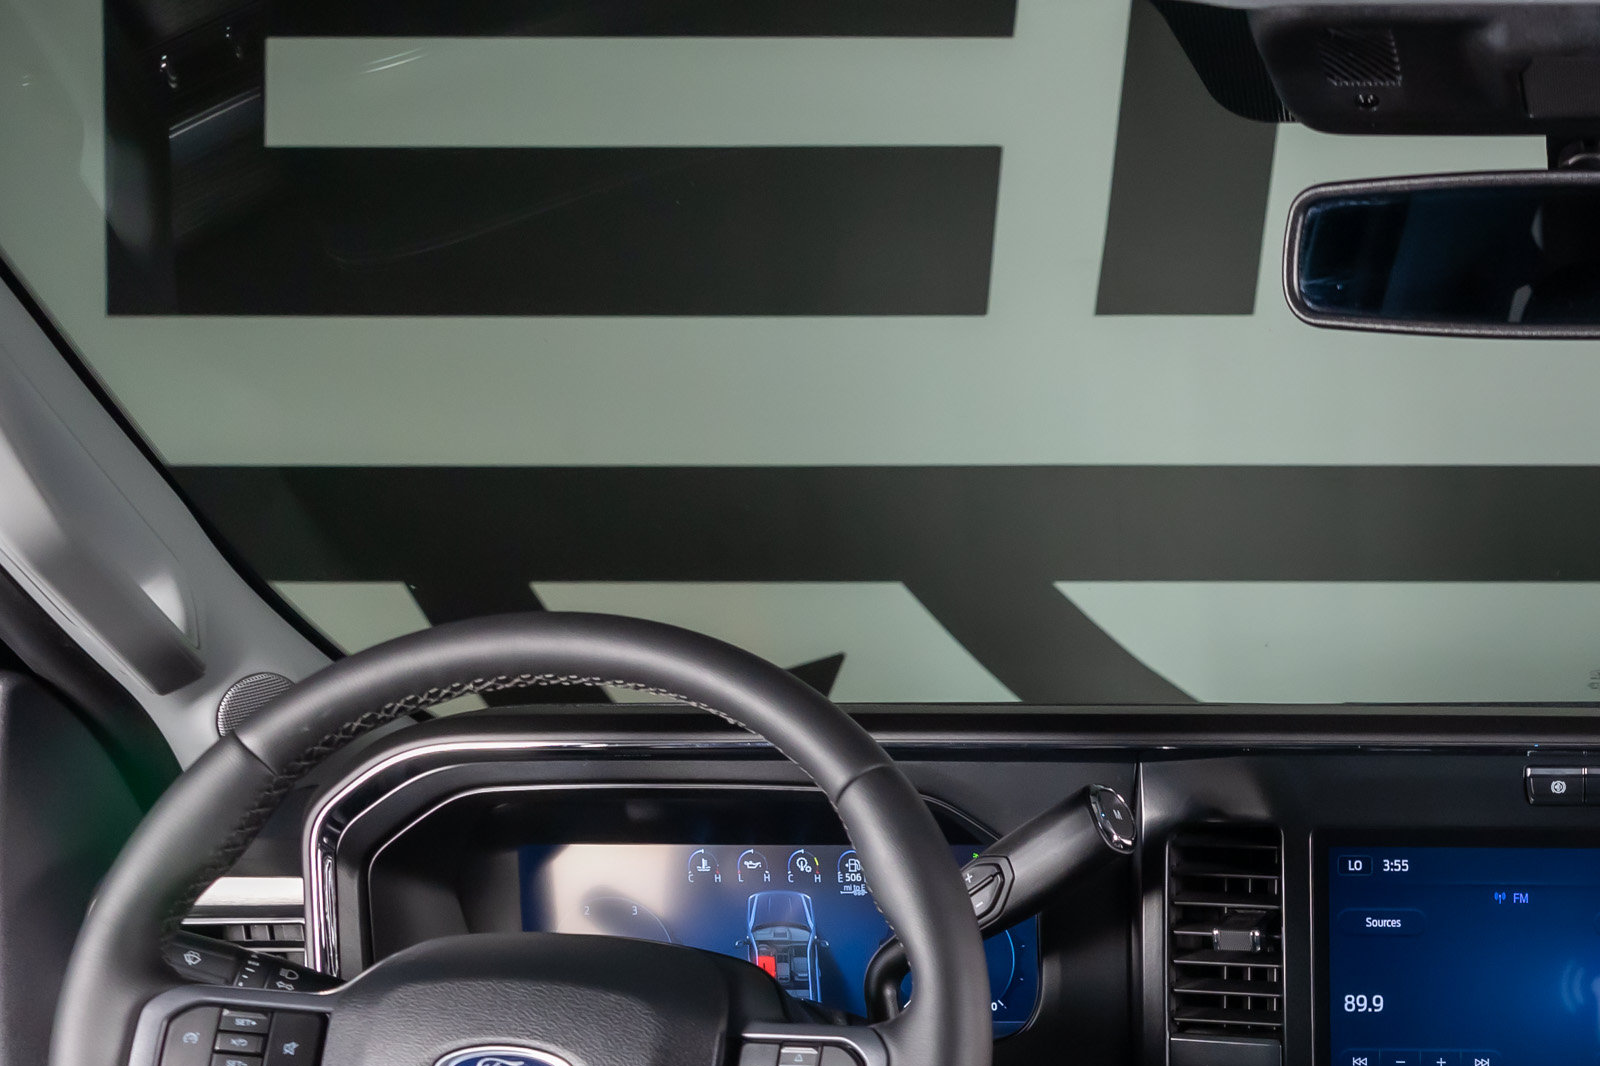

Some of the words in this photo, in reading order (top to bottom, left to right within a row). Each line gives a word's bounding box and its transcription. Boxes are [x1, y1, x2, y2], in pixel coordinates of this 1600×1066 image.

[1348, 859, 1363, 871] LO
[1383, 859, 1409, 872] 3:55
[714, 874, 722, 883] H
[738, 874, 744, 883] L
[814, 874, 822, 883] H
[845, 872, 862, 882] 506
[1513, 893, 1529, 904] FM
[584, 905, 591, 916] 2
[632, 905, 638, 916] 3
[1365, 917, 1402, 928] Sources
[1344, 994, 1384, 1014] 89.9
